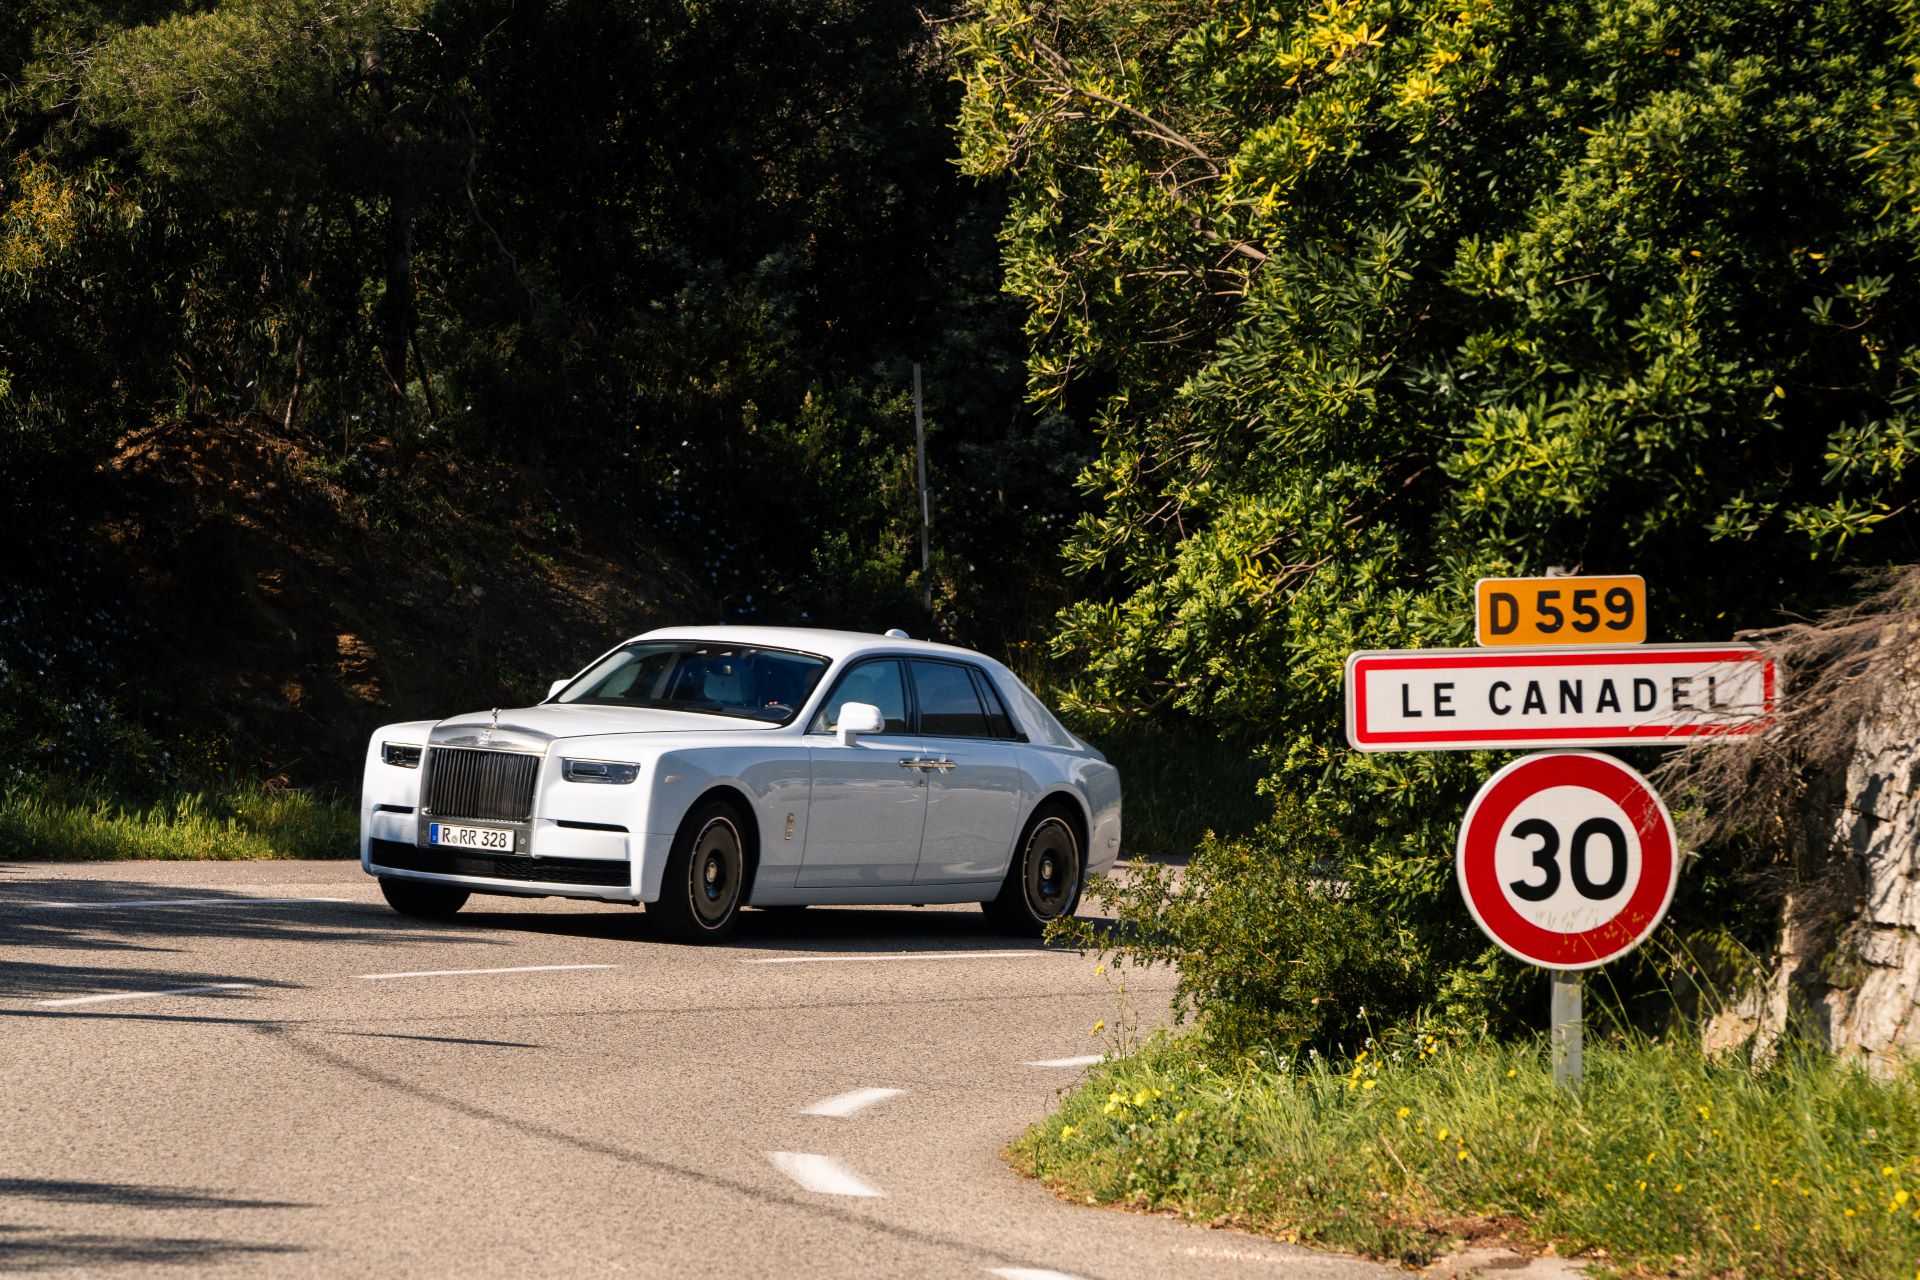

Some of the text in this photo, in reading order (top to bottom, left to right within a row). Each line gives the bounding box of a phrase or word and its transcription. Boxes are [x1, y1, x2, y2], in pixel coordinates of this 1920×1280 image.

[1489, 587, 1635, 635] D 559
[1401, 676, 1730, 718] LE CANADEL
[459, 829, 477, 845] RR
[481, 831, 507, 848] 328
[1509, 817, 1628, 902] 30
